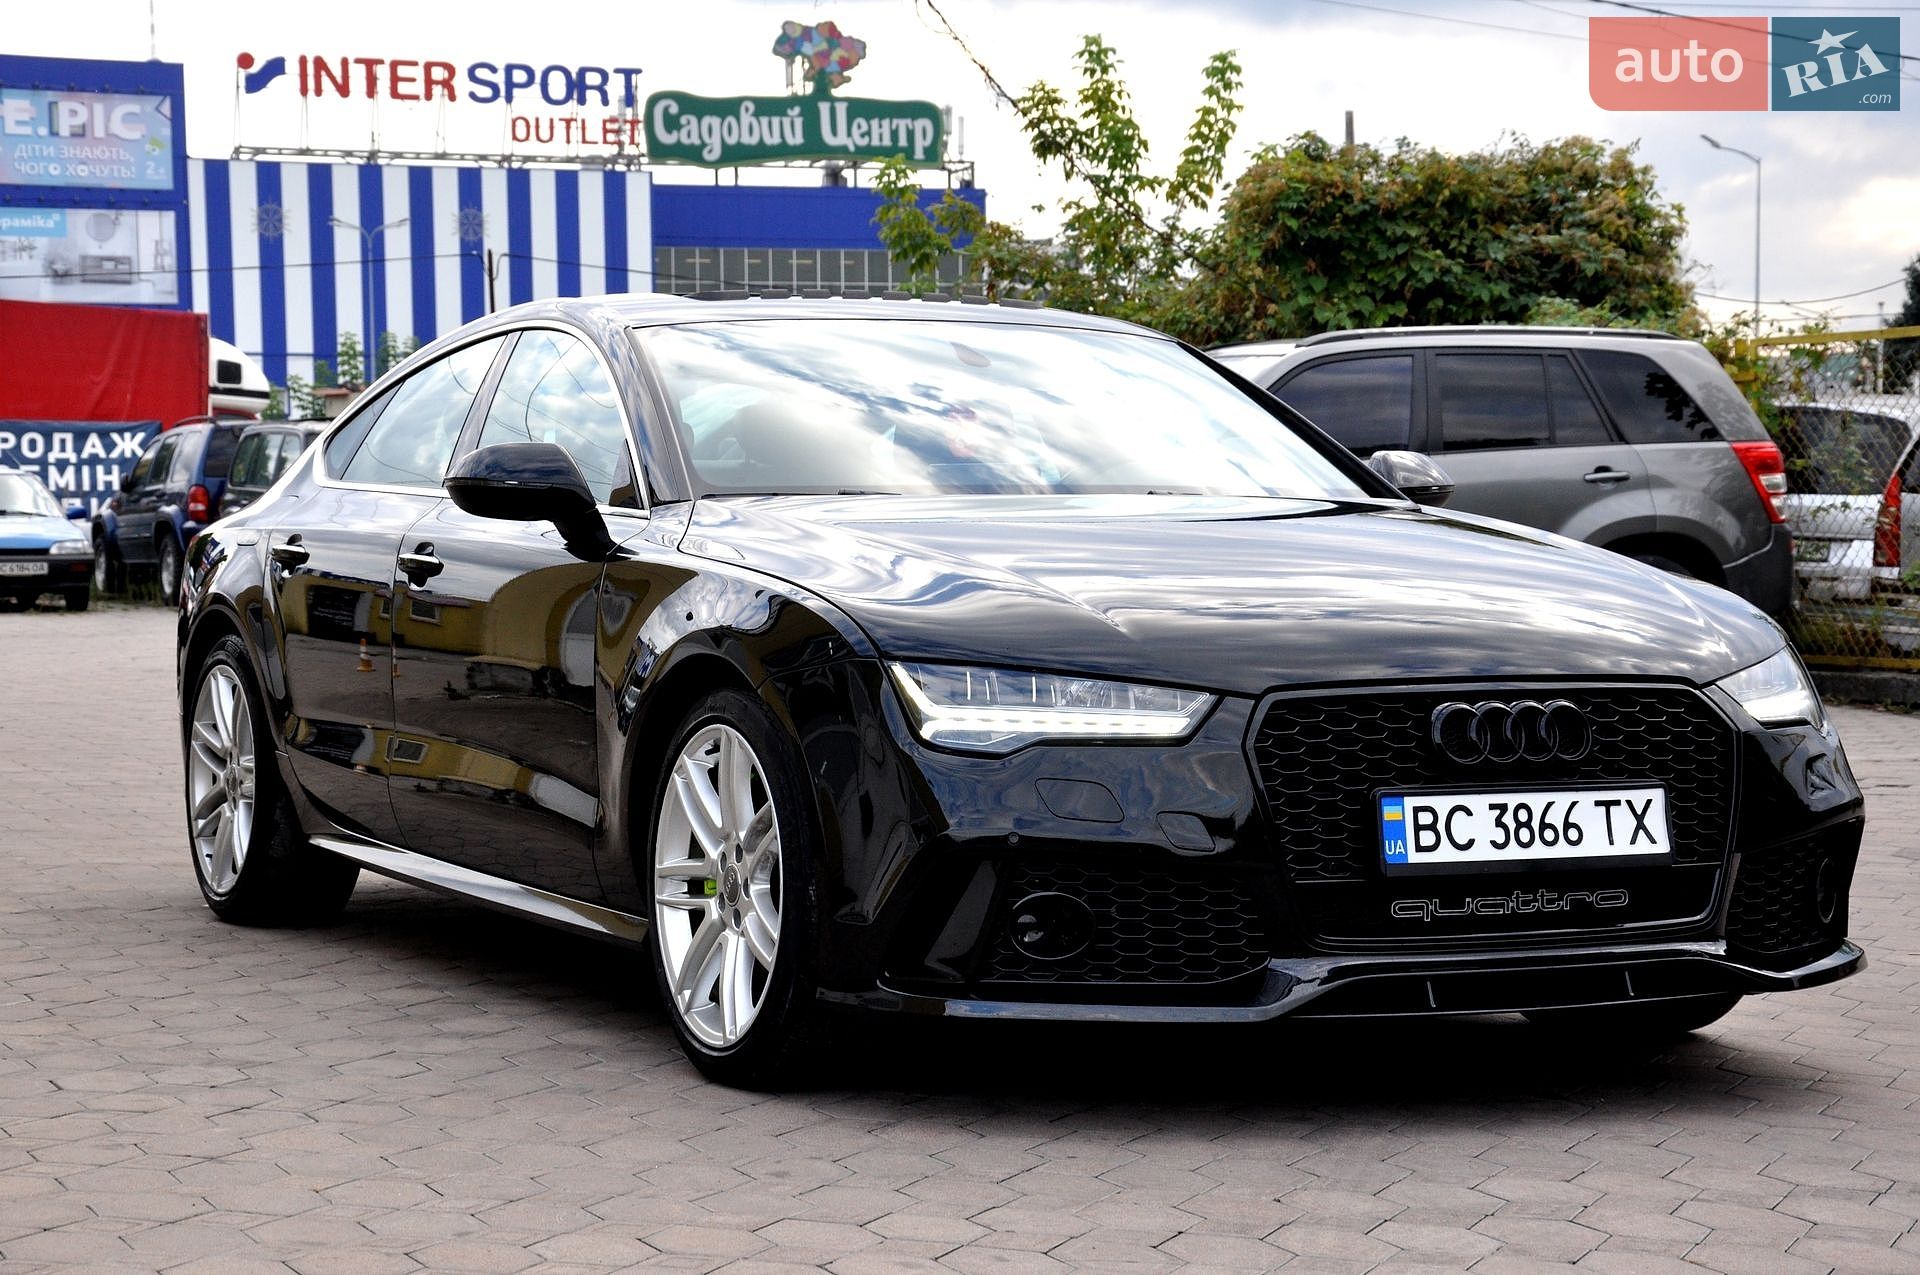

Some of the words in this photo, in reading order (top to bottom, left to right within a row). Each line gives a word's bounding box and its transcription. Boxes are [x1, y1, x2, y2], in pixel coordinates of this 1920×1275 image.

[511, 116, 643, 146] OUTLET
[653, 98, 805, 162] Садовий
[818, 101, 935, 160] Центр
[14, 143, 55, 159] ДІТИ
[14, 162, 62, 176] ЧОГО
[0, 431, 147, 464] РОДАЖ
[1412, 804, 1476, 853] BC
[1488, 800, 1584, 850] 3866
[1594, 799, 1658, 846] TX
[1385, 840, 1406, 855] UA
[1391, 889, 1629, 921] quattro
